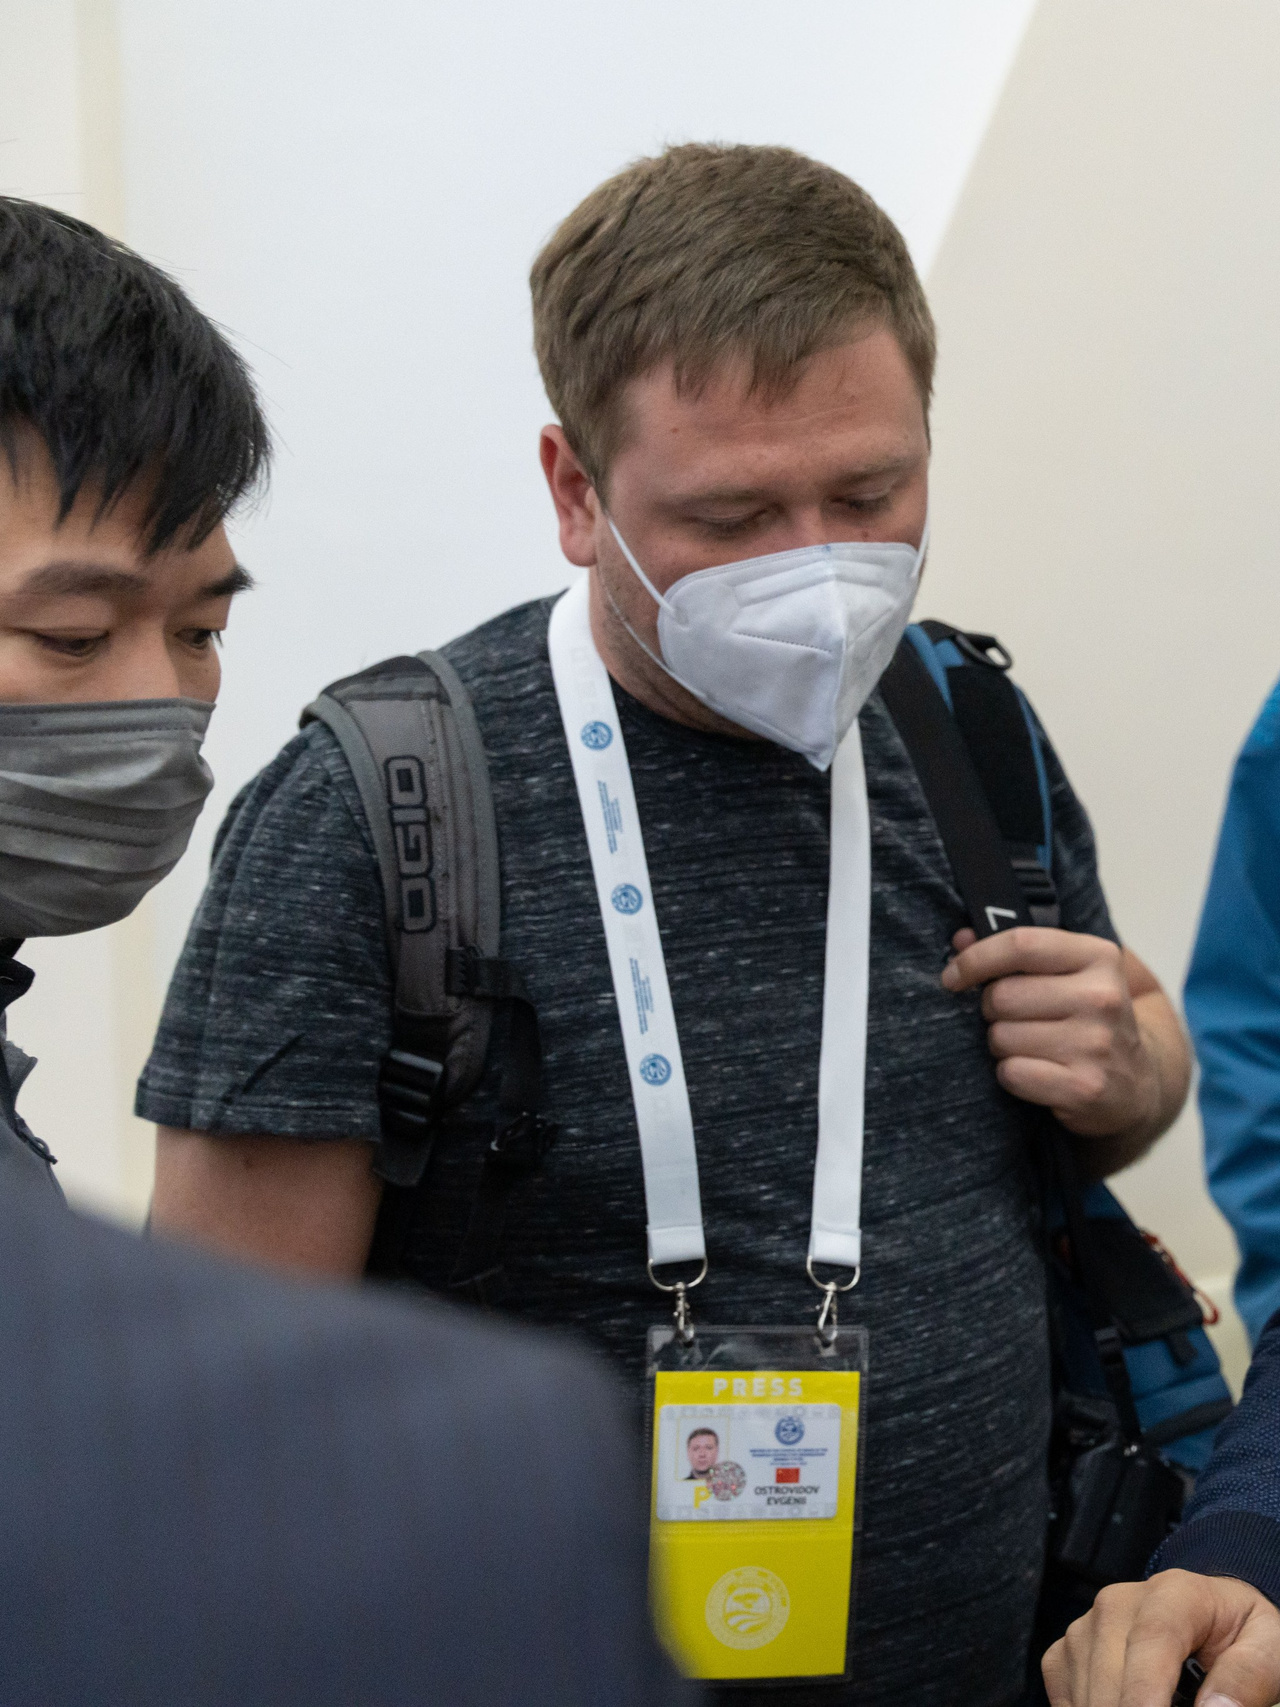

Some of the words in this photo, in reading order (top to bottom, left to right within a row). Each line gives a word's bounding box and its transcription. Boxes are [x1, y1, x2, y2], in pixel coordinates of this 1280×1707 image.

[384, 755, 437, 933] OGIO
[713, 1378, 803, 1397] PRESS
[693, 1486, 711, 1510] P
[753, 1485, 821, 1496] OSTROVIDOV
